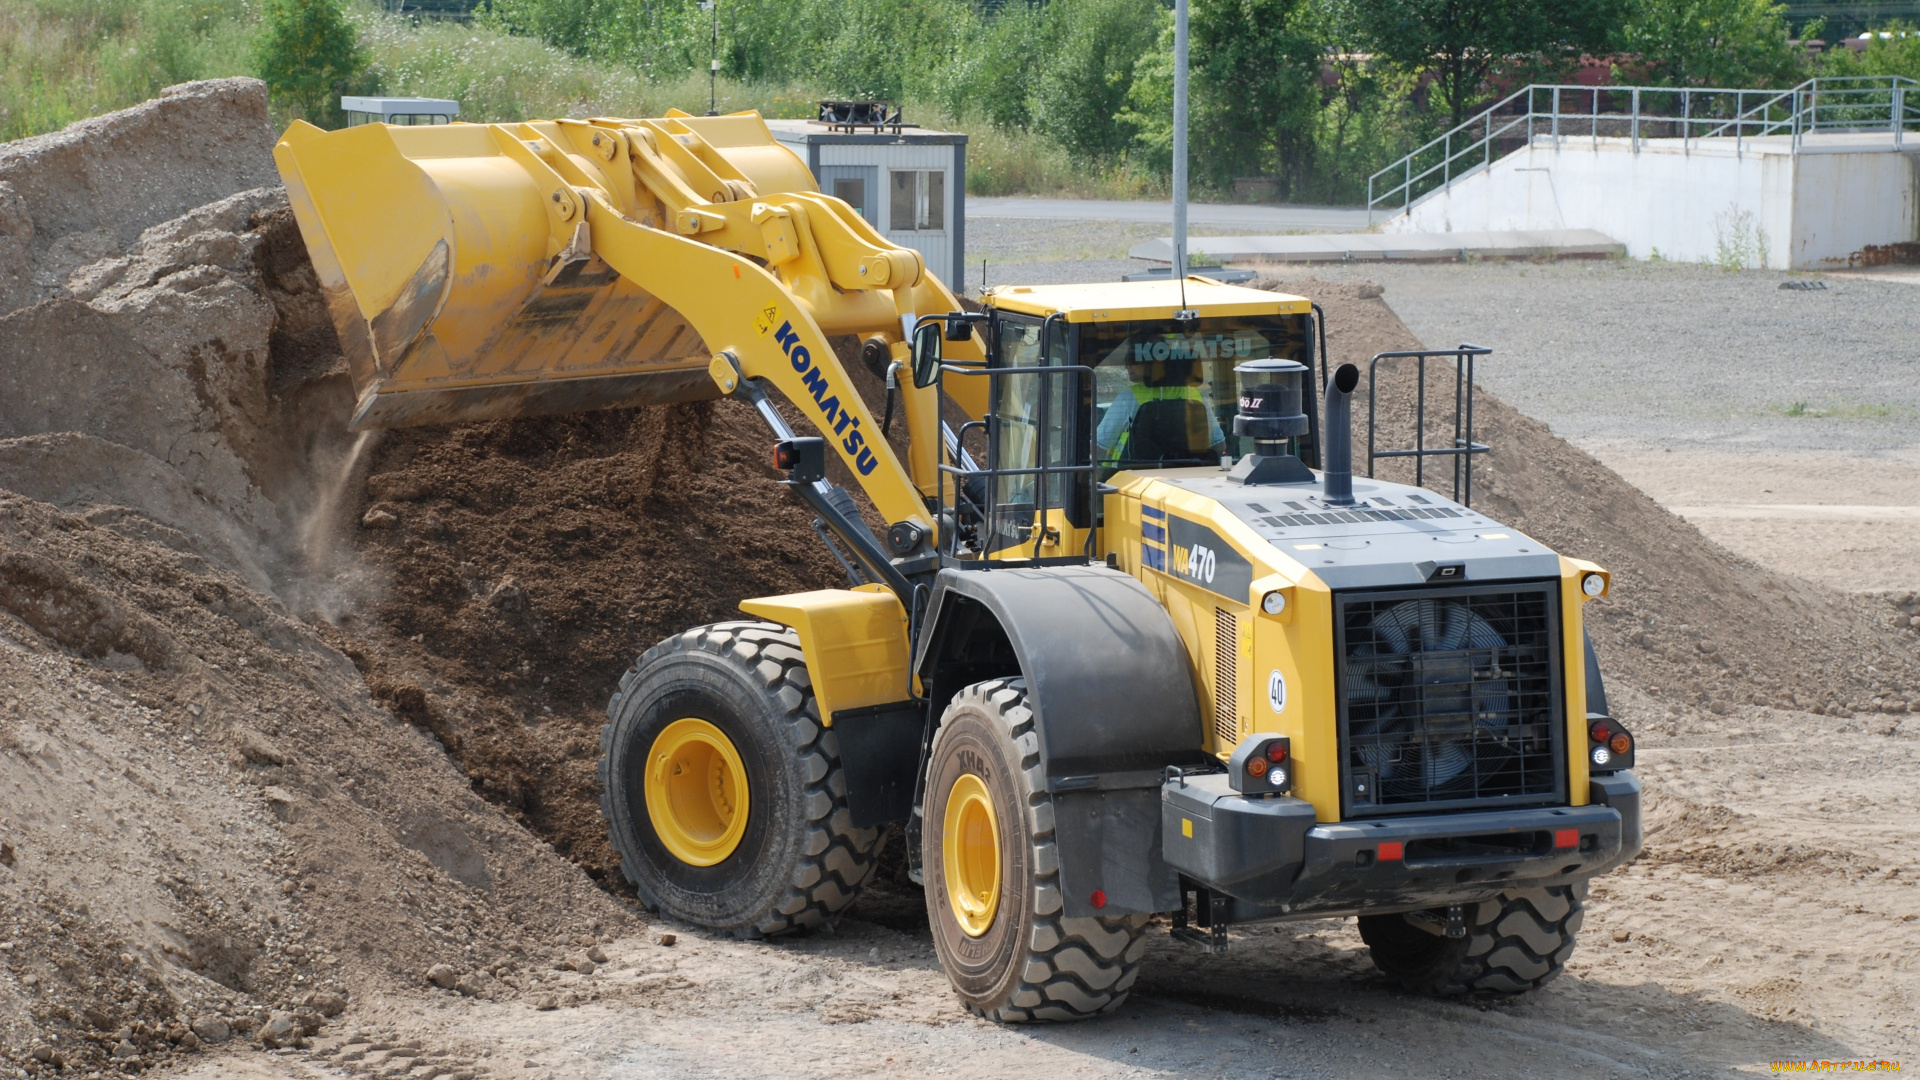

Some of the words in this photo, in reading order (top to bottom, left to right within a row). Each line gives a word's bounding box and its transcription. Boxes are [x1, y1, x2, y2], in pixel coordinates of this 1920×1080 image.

[1134, 334, 1251, 362] KOMATSU
[774, 320, 879, 476] KOMATSU
[1271, 677, 1283, 706] 40
